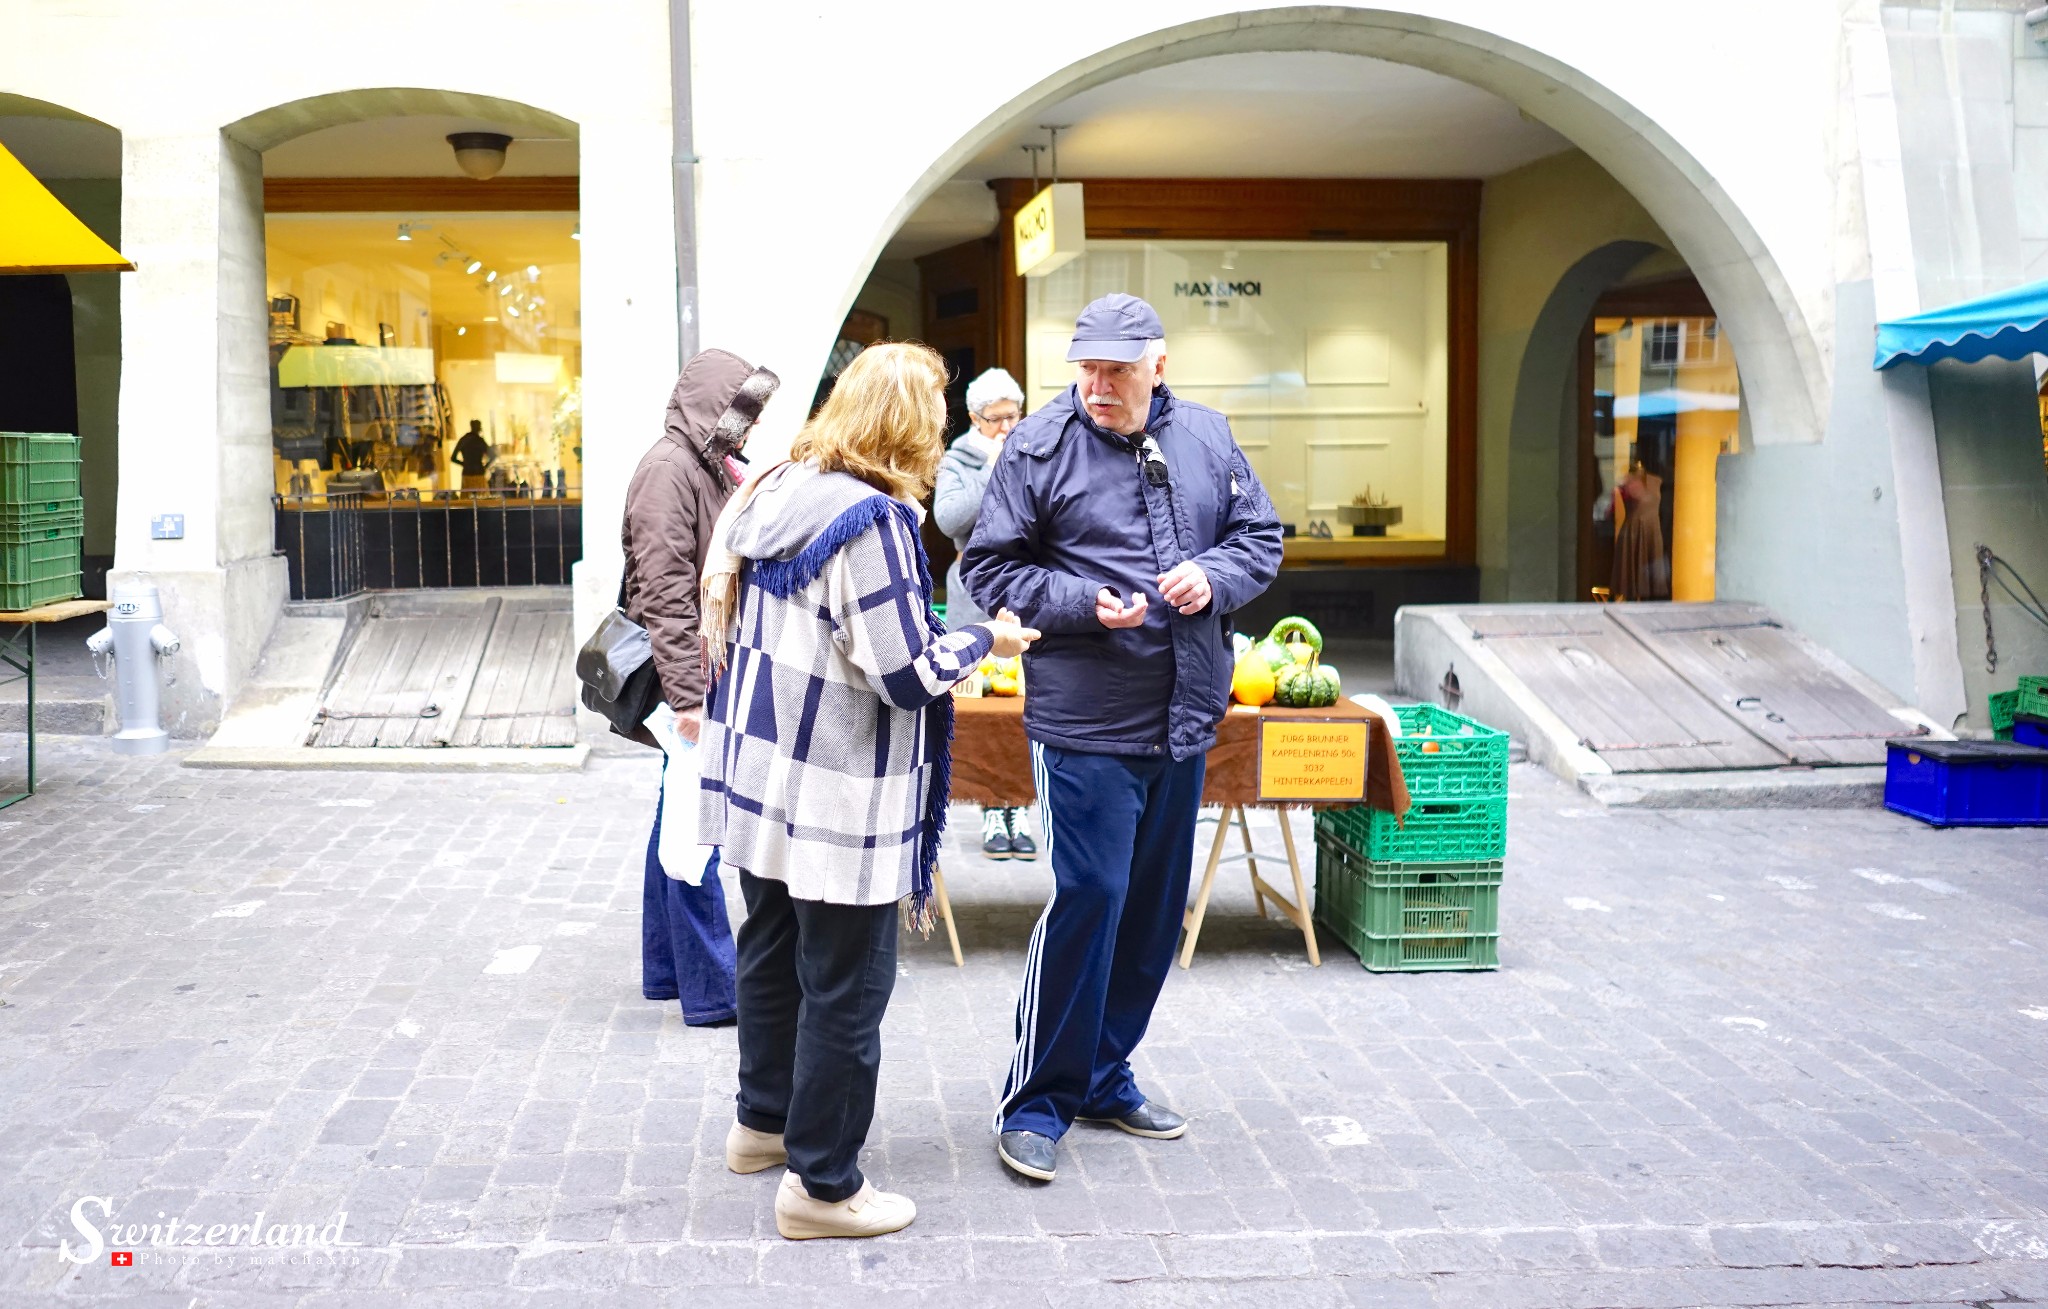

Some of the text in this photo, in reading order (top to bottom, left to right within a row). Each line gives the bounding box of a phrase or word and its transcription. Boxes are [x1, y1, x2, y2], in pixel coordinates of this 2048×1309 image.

[1174, 281, 1261, 297] MAX&MOI
[1306, 735, 1349, 743] BRUNNER
[1272, 749, 1339, 758] KAPPELENRING
[1303, 764, 1325, 772] 3032
[1273, 777, 1353, 786] HINTERKAPPELEN
